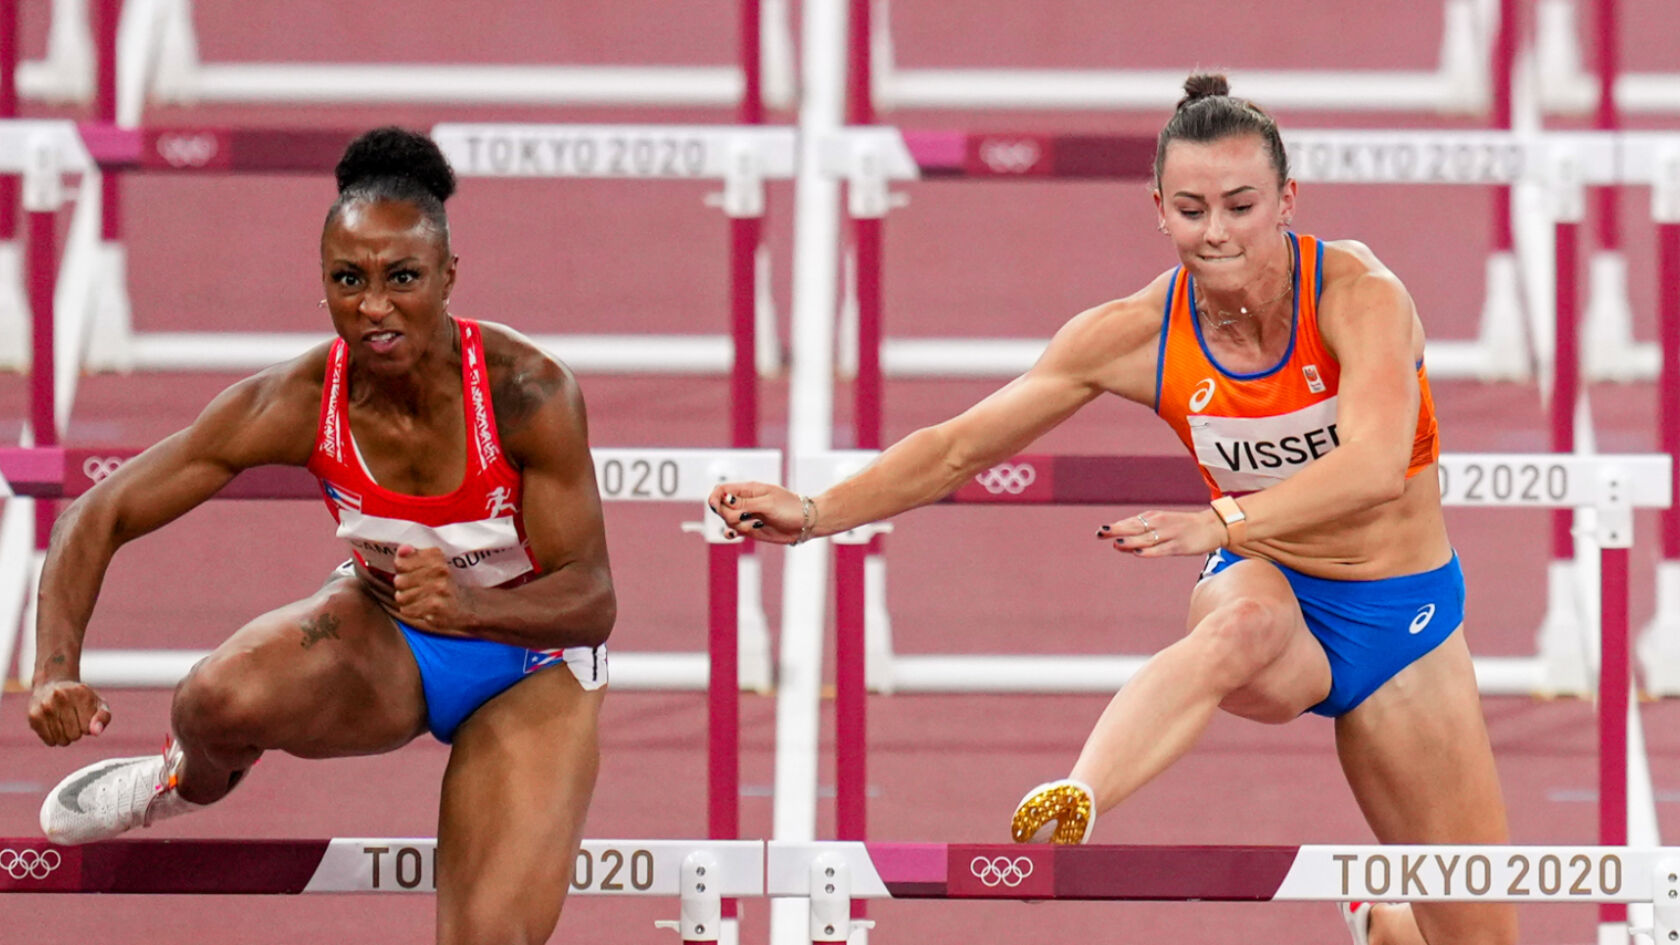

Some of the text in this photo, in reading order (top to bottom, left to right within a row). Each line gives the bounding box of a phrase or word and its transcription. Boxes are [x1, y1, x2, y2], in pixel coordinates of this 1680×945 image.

[466, 136, 707, 175] TOKYO 2020
[1427, 143, 1526, 181] 2020
[603, 459, 678, 496] 020
[1464, 463, 1567, 500] 2020
[571, 849, 655, 890] 020
[1332, 854, 1622, 896] TOKYO 2020
